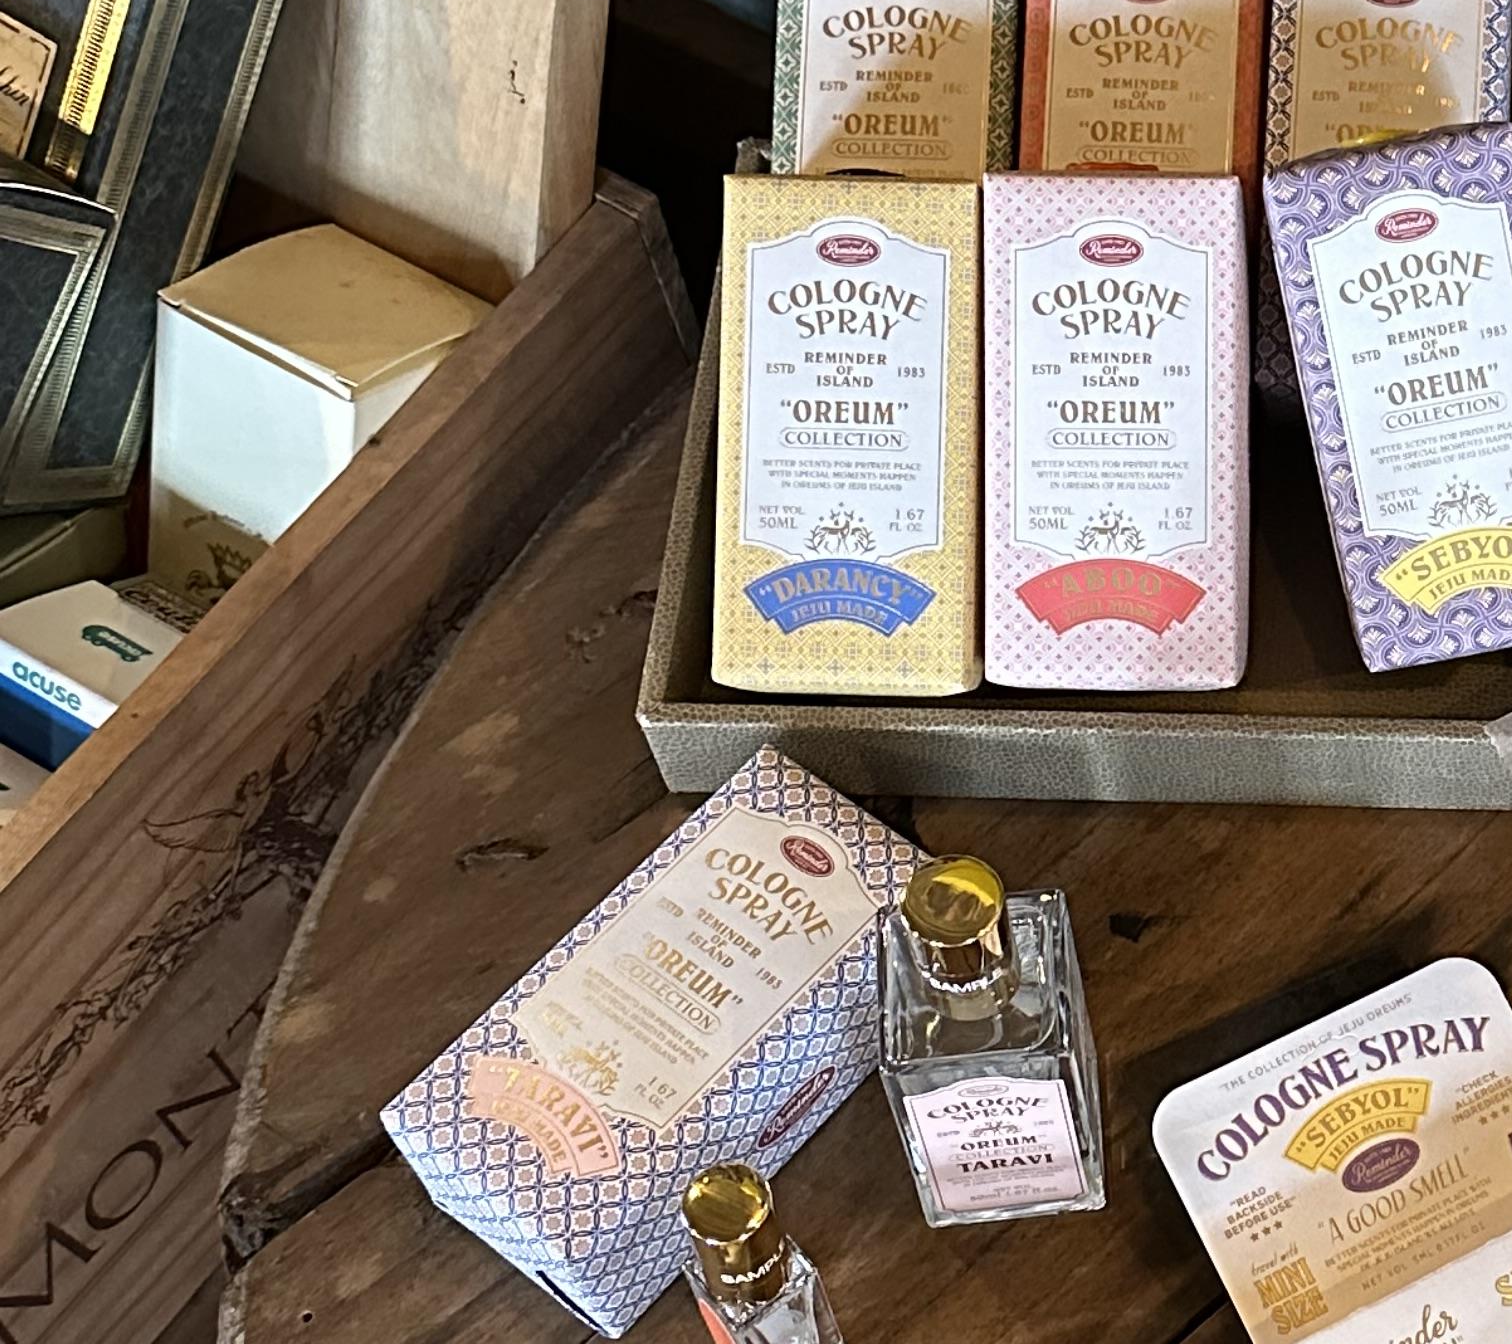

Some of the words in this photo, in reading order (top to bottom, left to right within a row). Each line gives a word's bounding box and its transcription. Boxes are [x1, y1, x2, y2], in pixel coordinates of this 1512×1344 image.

[822, 7, 972, 43] COLOGNE
[1069, 16, 1217, 53] COLOGNE
[848, 32, 947, 61] SPRAY
[1094, 42, 1193, 69] SPRAY
[855, 70, 933, 83] REMINDER
[1102, 79, 1180, 92] REMINDER
[865, 90, 920, 103] ISLAND
[1339, 250, 1493, 305] COLOGNE
[768, 278, 928, 322] COLOGNE
[1032, 279, 1192, 321] COLOGNE
[1370, 282, 1473, 323] SPRAY
[796, 310, 902, 341] SPRAY
[1061, 309, 1166, 340] SPRAY
[1387, 320, 1469, 347] REMINDER
[804, 352, 887, 366] REMINDER
[1070, 352, 1152, 365] REMINDER
[1404, 345, 1461, 366] ISLAND
[816, 375, 874, 387] ISLAND
[836, 365, 854, 376] OF
[897, 366, 926, 379] 1983
[1082, 375, 1140, 387] ISLAND
[1386, 397, 1499, 429] COLLECTION
[785, 432, 902, 447] COLLECTION
[1053, 432, 1169, 446] COLLECTION
[759, 516, 798, 529] 50ML
[1429, 573, 1468, 600] JEJU
[13, 661, 82, 711] acuse
[704, 847, 834, 945] COLOGNE
[708, 878, 798, 943] SPRAY
[697, 907, 761, 960] REMINDER
[688, 932, 734, 968] ISLAND
[927, 1097, 1048, 1118] COLOGNE
[1197, 1048, 1358, 1181] COLOGNE
[1358, 1016, 1490, 1072] SPRAY
[1329, 1135, 1360, 1161] JEJU
[1363, 1116, 1405, 1135] MADE
[958, 1153, 1053, 1172] TARAVI
[1227, 1191, 1283, 1225] BACKSIDE
[1347, 1191, 1406, 1233] GOOD
[1225, 1212, 1268, 1239] BEFORE
[1254, 1257, 1318, 1308] MINI
[1270, 1289, 1329, 1335] SIZE
